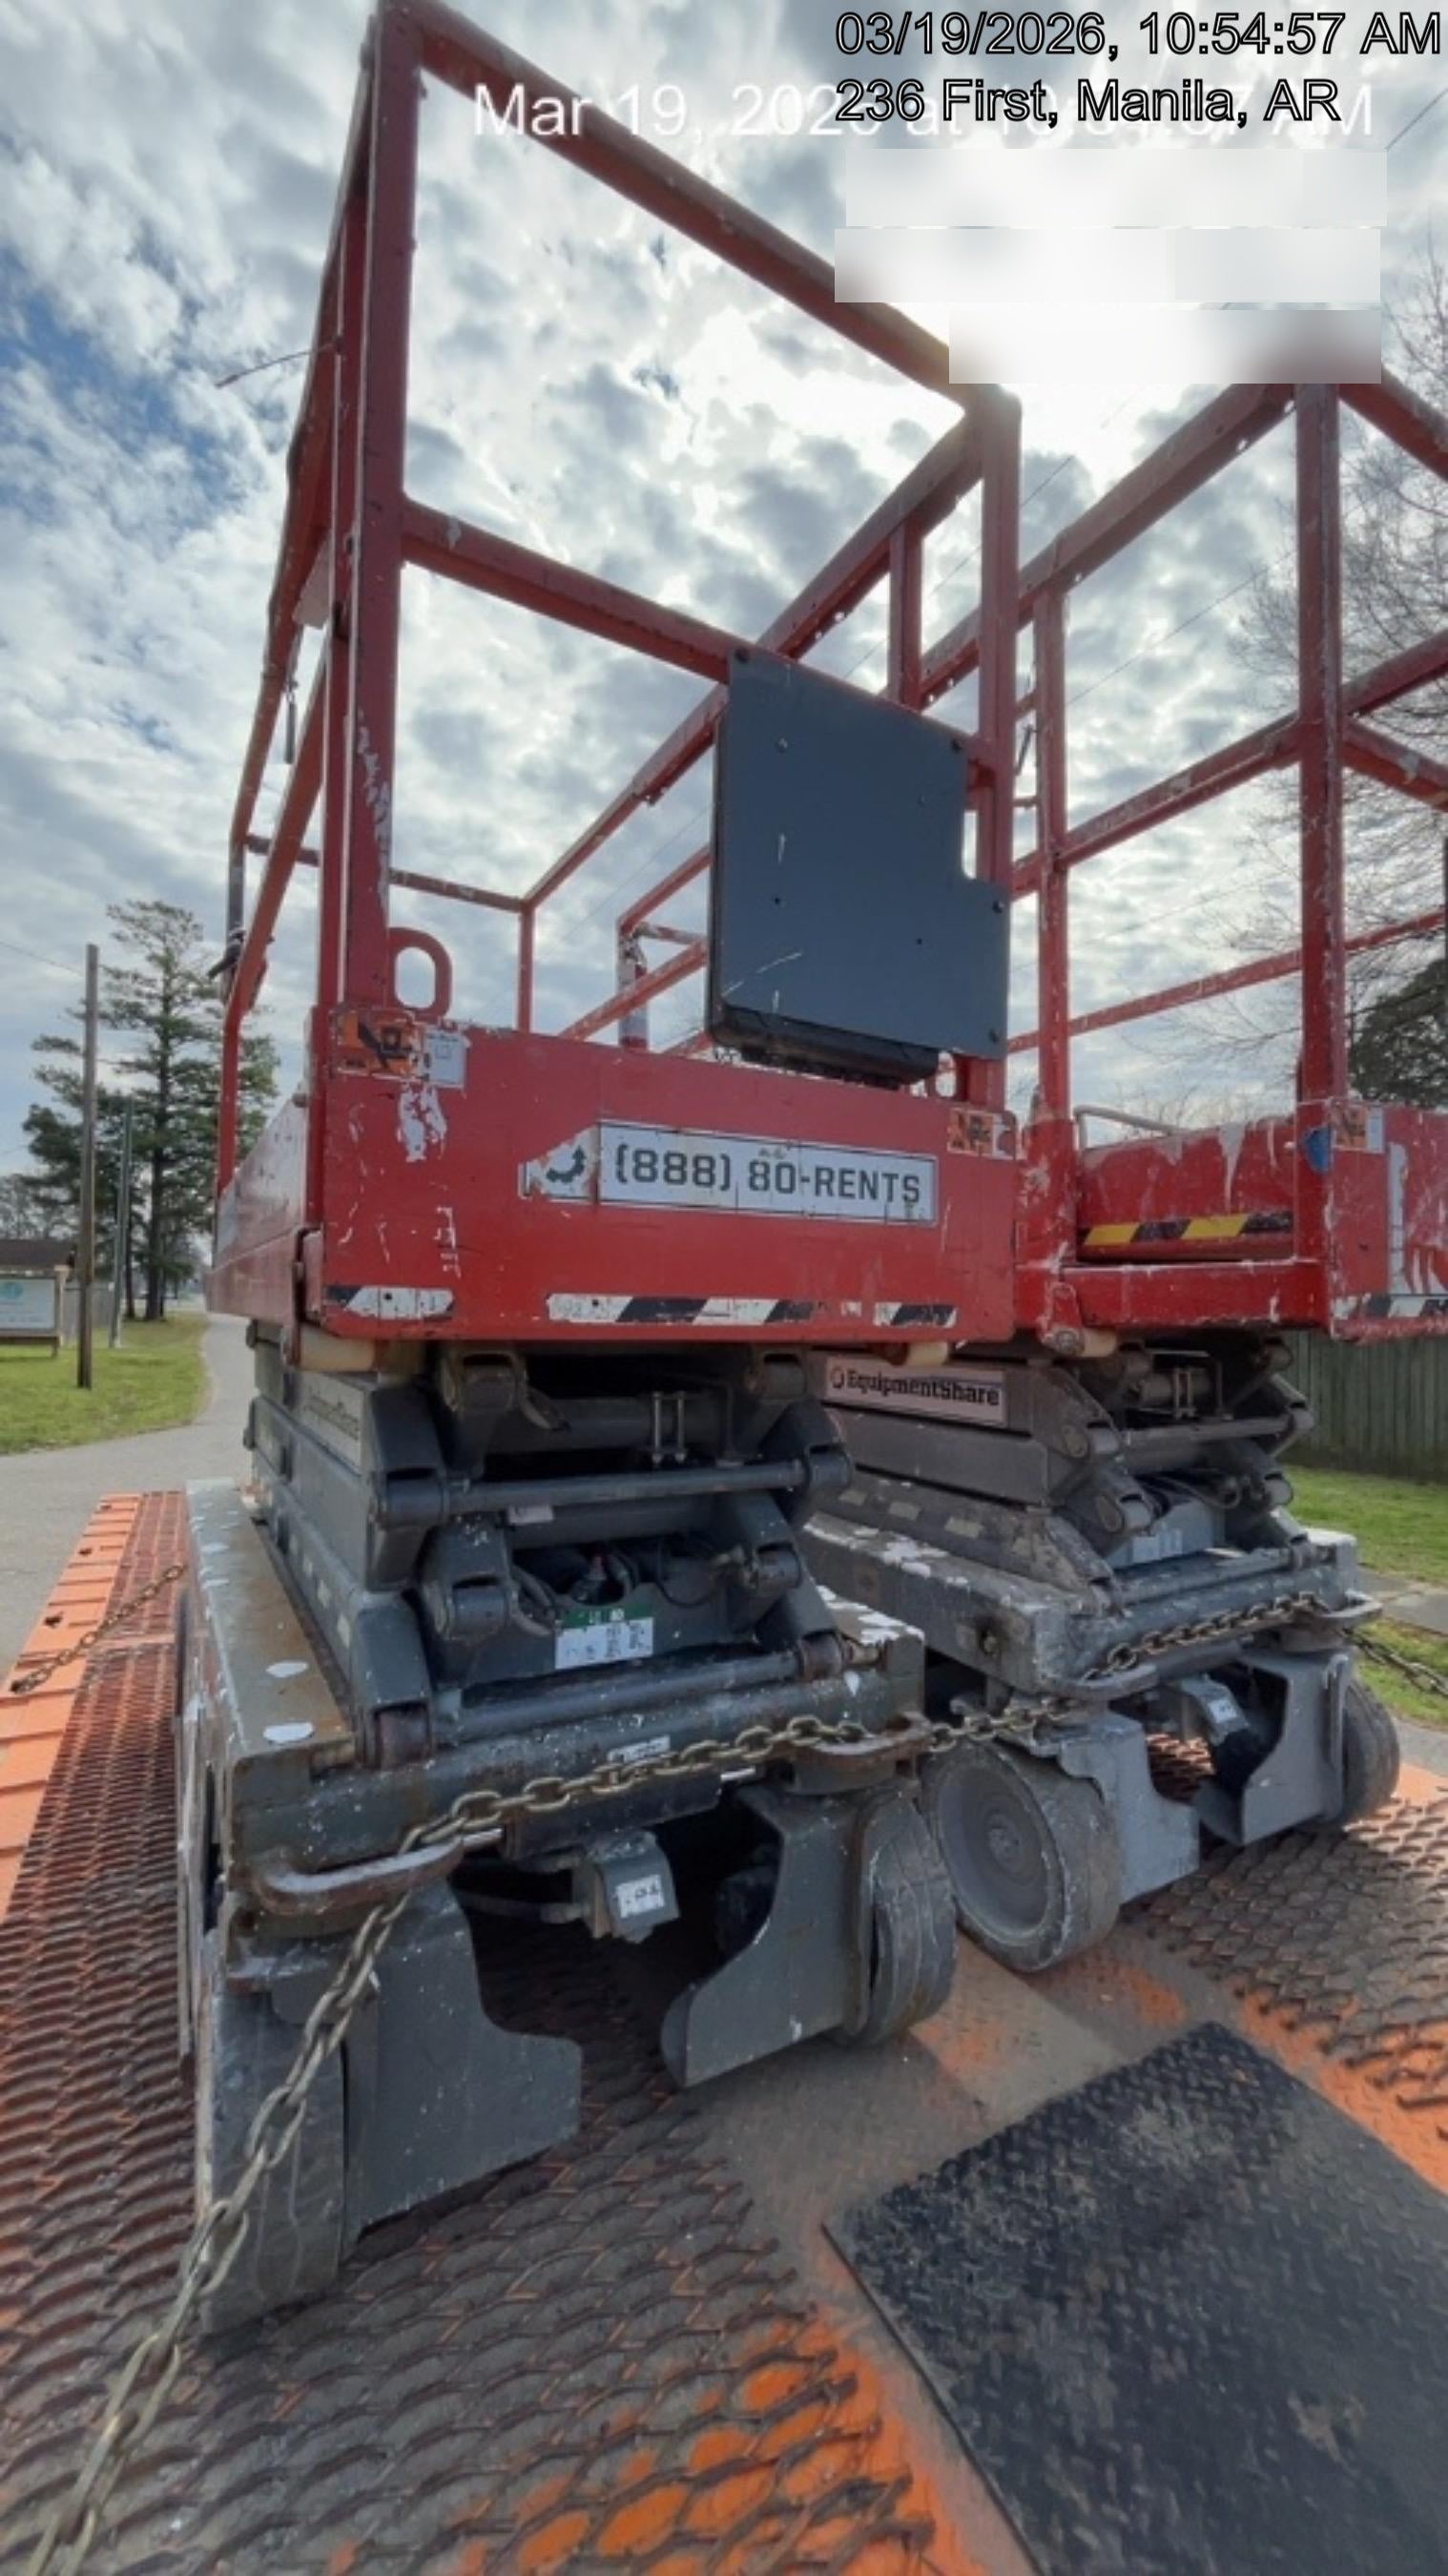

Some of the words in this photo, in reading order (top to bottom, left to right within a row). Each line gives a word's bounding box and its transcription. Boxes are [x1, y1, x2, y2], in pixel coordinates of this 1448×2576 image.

[615, 1144, 732, 1192] (888)
[749, 1159, 921, 1204] 80-RENTS
[847, 1369, 1001, 1406] EquipmentShare
